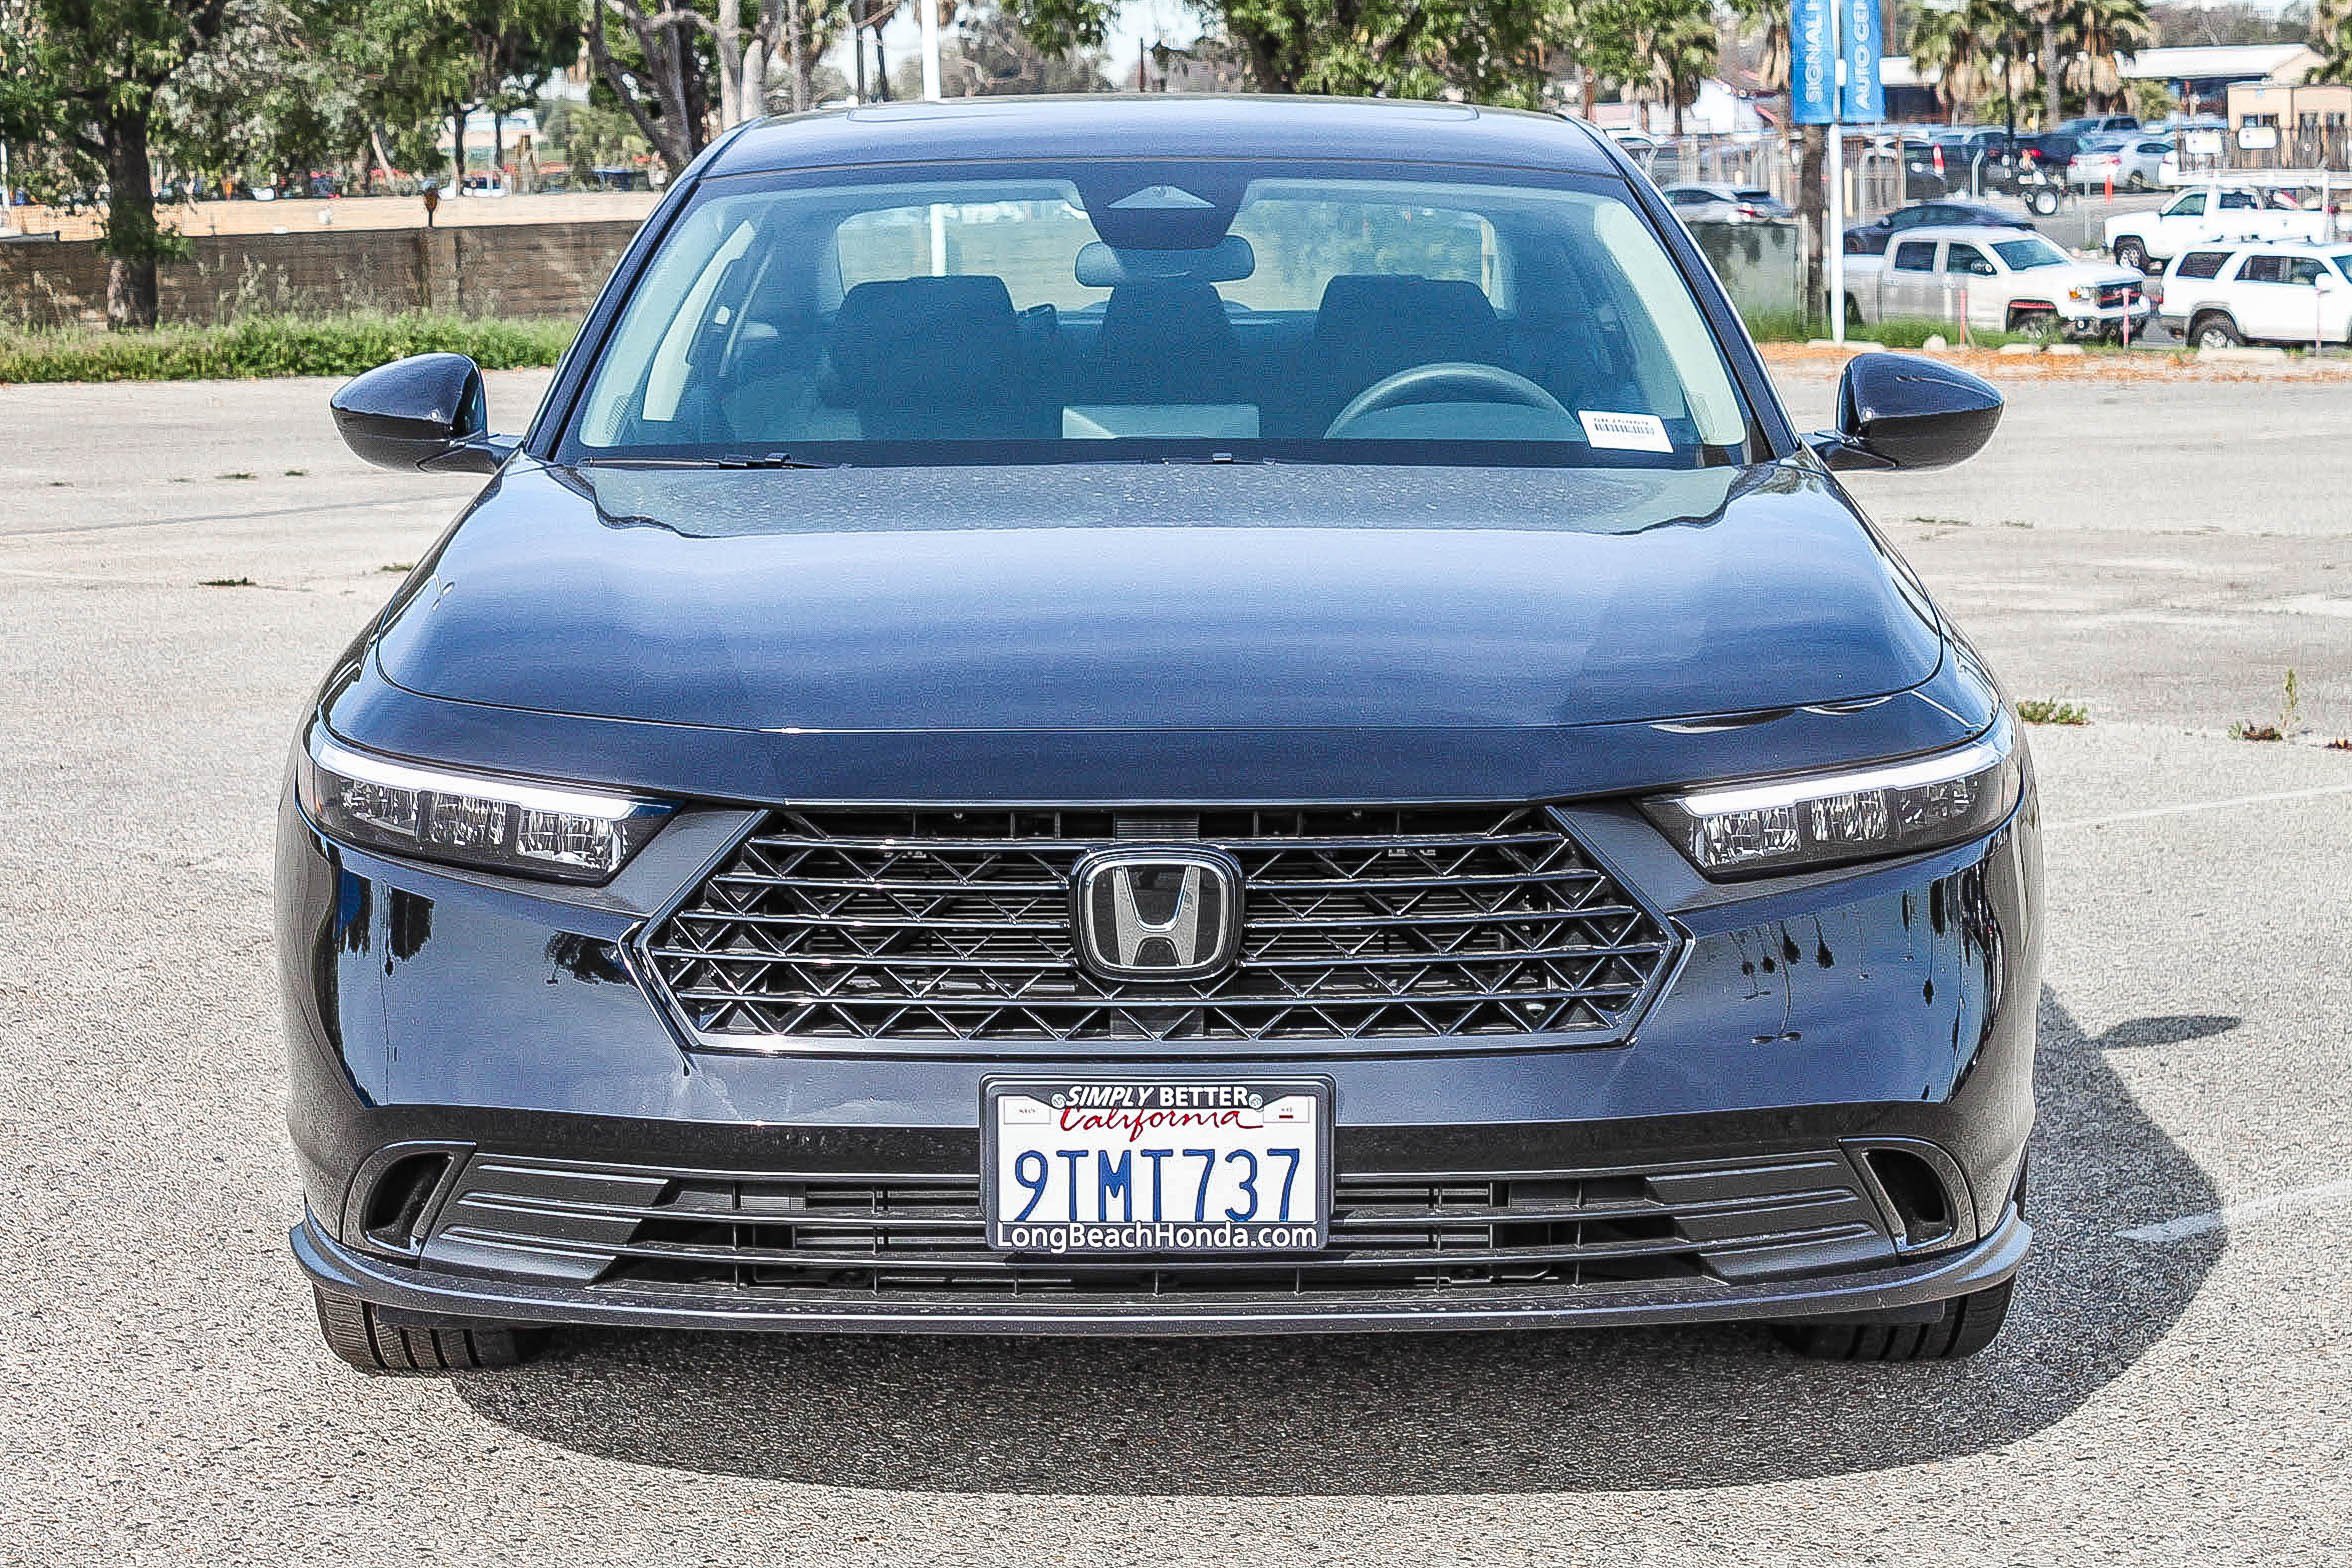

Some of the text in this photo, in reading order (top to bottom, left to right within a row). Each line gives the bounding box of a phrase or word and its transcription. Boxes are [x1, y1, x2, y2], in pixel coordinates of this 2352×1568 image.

[1805, 14, 1823, 103] SIGNAL
[1854, 44, 1871, 110] AUTO
[1067, 1086, 1249, 1107] SIMPLY BETTER
[1060, 1107, 1263, 1142] California
[1014, 1149, 1300, 1222] 9TMT737
[997, 1222, 1317, 1253] LongBeachHonda.com
